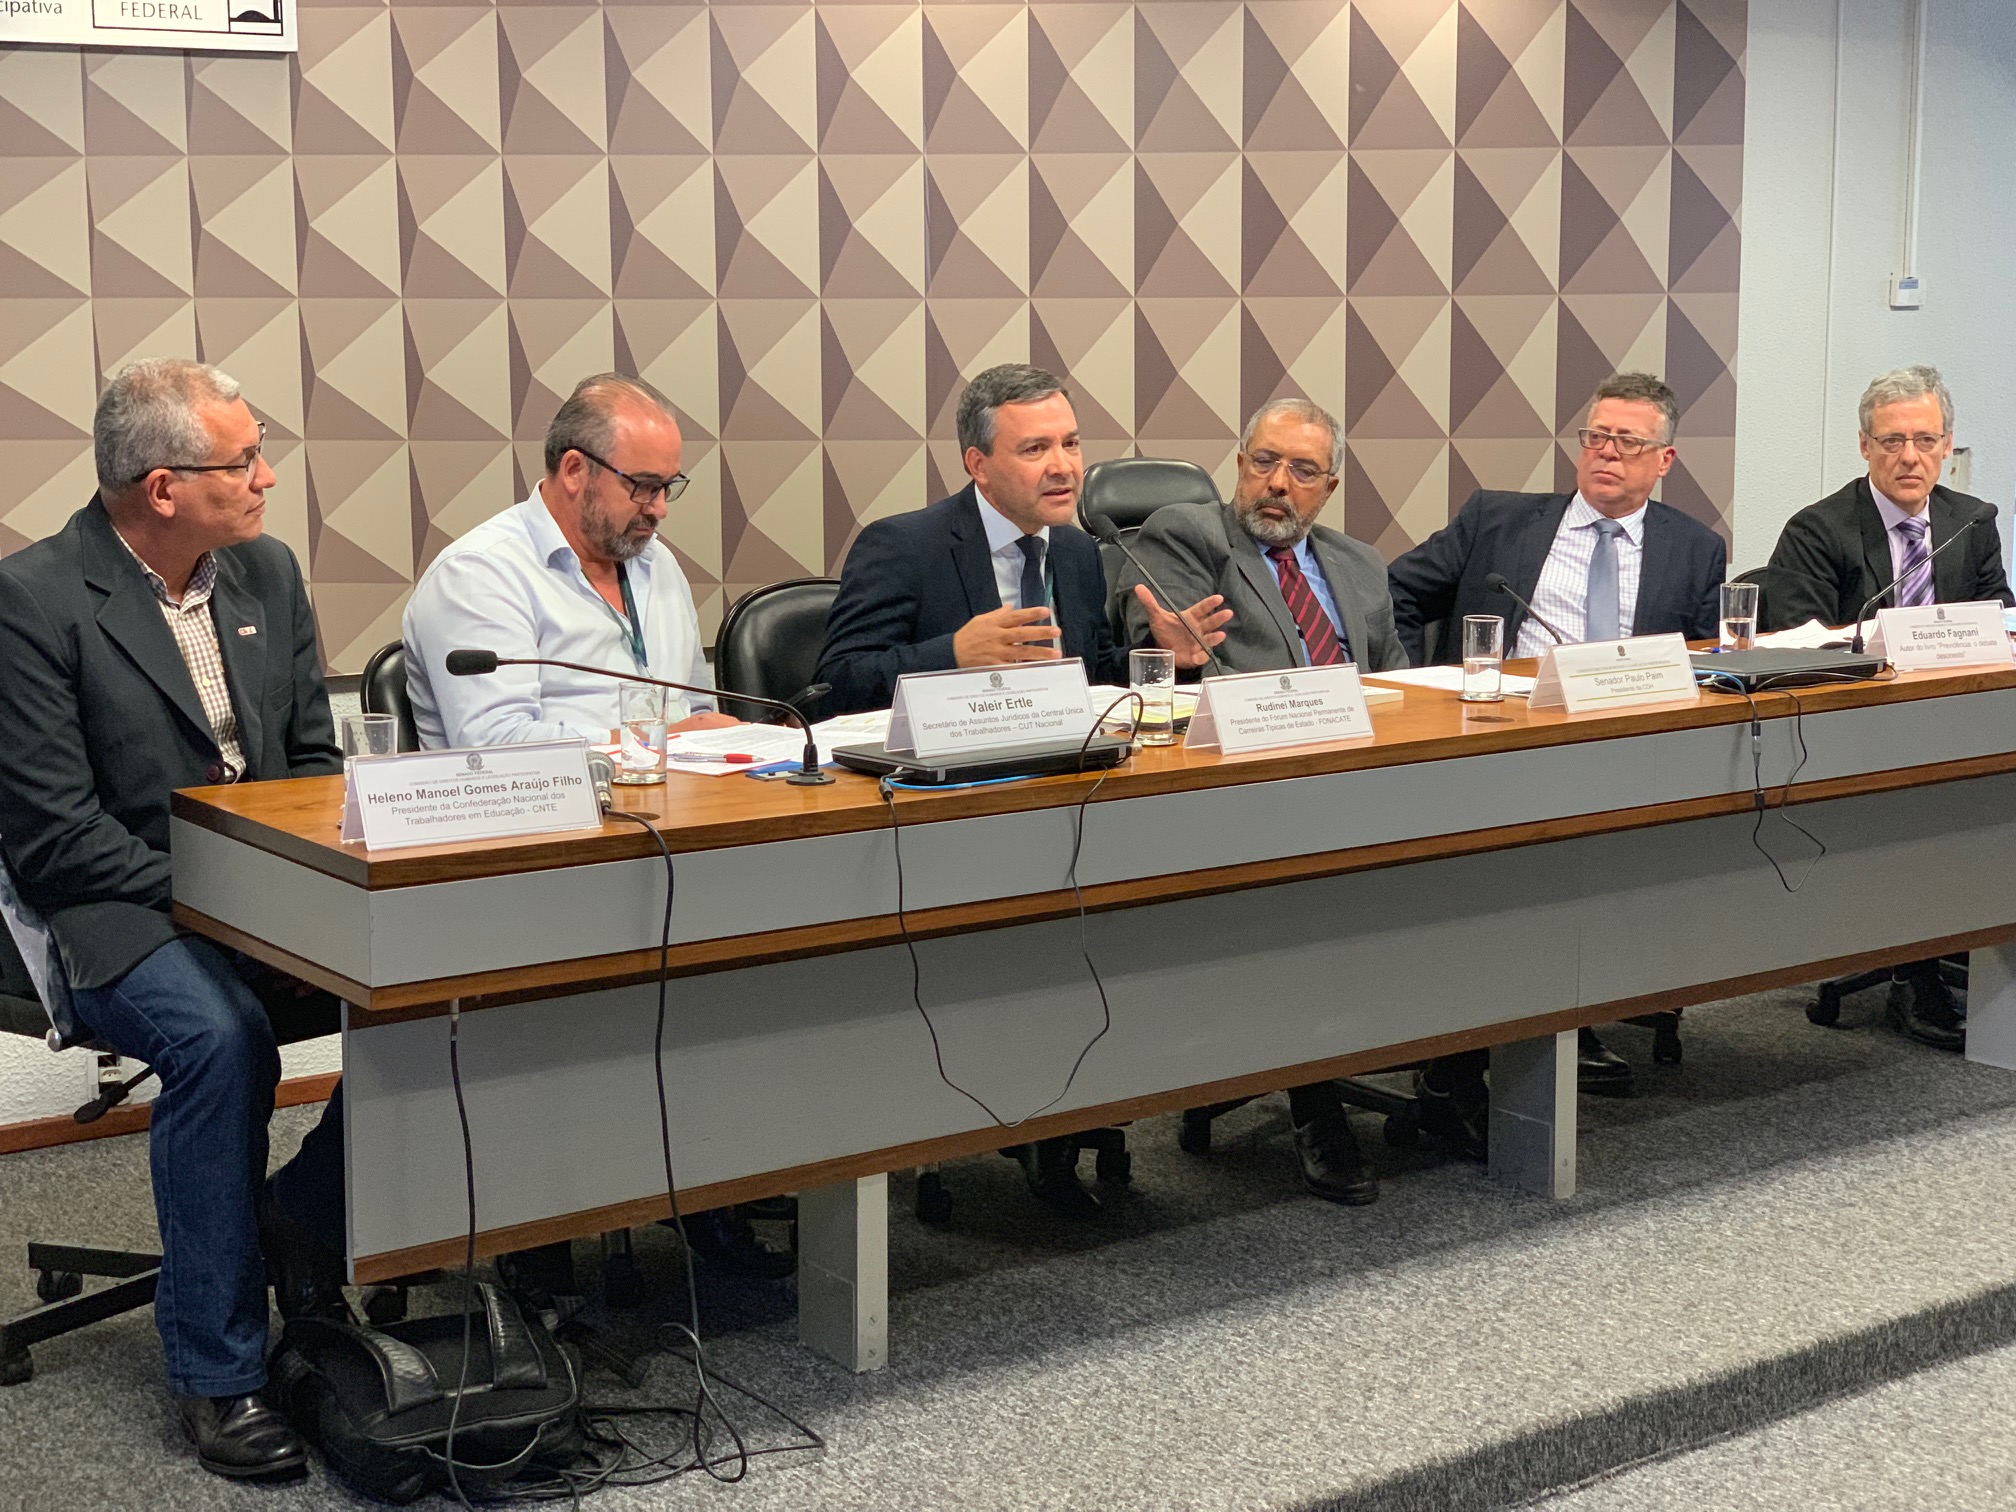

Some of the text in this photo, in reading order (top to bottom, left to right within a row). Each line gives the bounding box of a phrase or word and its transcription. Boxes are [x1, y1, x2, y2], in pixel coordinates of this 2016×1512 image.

[121, 1, 203, 20] FEDERAL
[1912, 627, 1979, 640] Eduardo Fagnani
[1594, 671, 1664, 686] Senador Paulo Paim
[1610, 685, 1635, 693] Presidente
[968, 697, 1033, 713] Valeir Ertle
[1256, 698, 1323, 712] Rudinei Marques
[922, 705, 1084, 731] Secretário de Assuntos Jurídicos da Central Única
[1230, 717, 1261, 725] Presidente
[1269, 713, 1288, 721] Fórum
[1288, 710, 1313, 719] Nacional
[1313, 706, 1346, 715] Permanente
[1238, 726, 1265, 735] Carreiras
[1294, 719, 1314, 728] Estado
[1318, 715, 1351, 725] FONACATE
[949, 730, 963, 738] dos
[963, 725, 1011, 736] Trabalhadores
[1018, 721, 1033, 731] CUT
[1034, 719, 1063, 728] Nacional
[367, 775, 582, 804] Heleno Manoel Gomes Araújo Filho
[391, 791, 566, 815] Presidente da Confederação Nacional dos
[404, 813, 467, 826] Trabalhadores
[468, 812, 482, 820] em
[483, 806, 525, 818] Educação
[532, 802, 558, 813] CNTE
